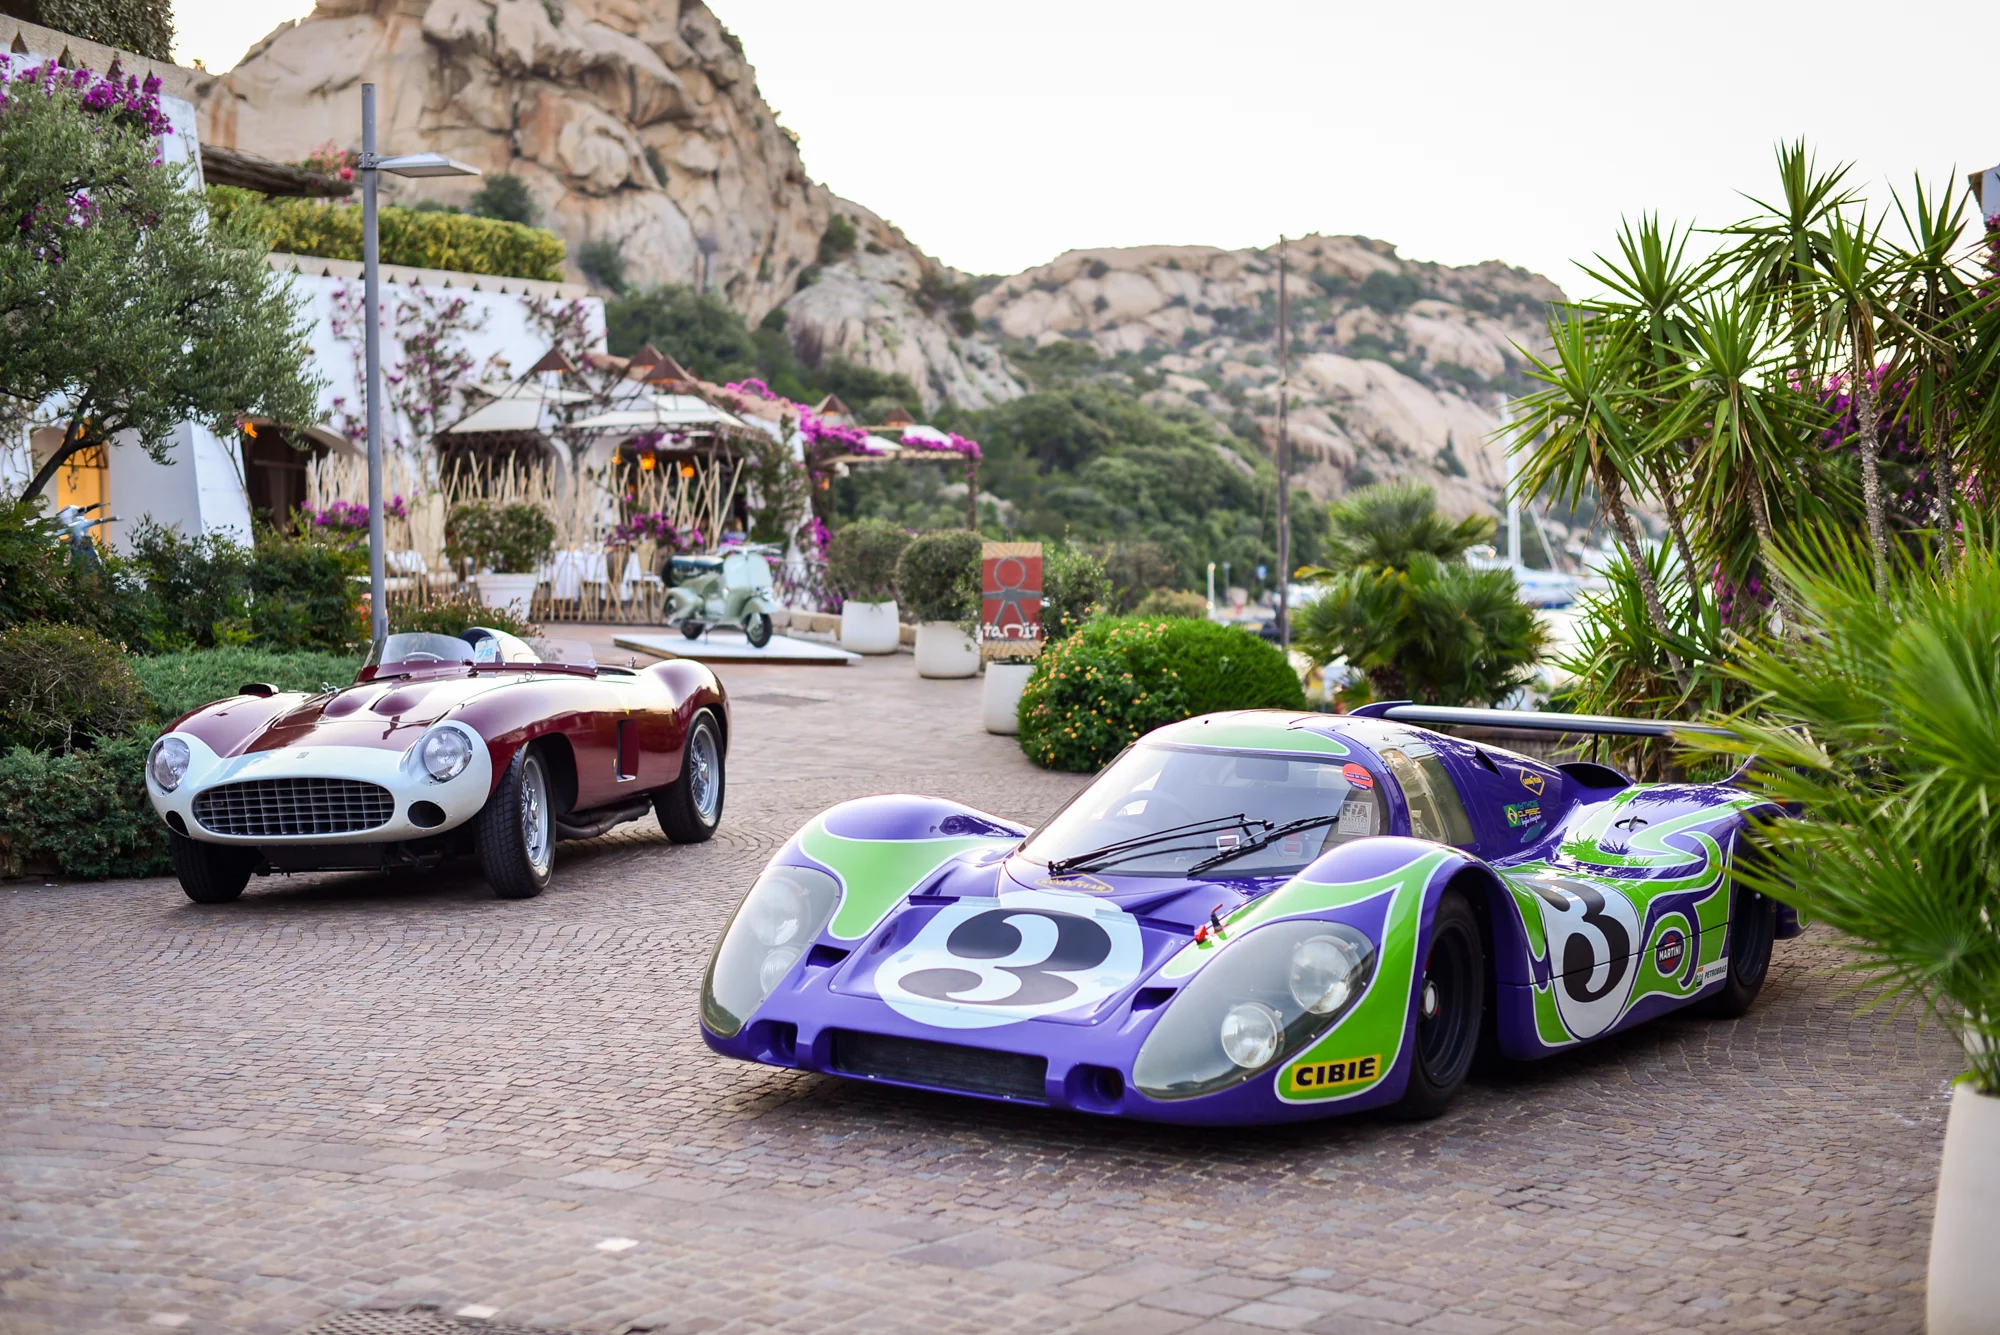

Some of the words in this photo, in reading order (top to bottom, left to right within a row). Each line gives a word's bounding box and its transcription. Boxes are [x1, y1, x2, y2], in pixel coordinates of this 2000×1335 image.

[477, 647, 493, 659] 78
[1519, 878, 1631, 1003] 3
[897, 907, 1112, 1006] 3
[1658, 944, 1682, 961] MARTINI
[1704, 964, 1728, 980] PETROBRAS
